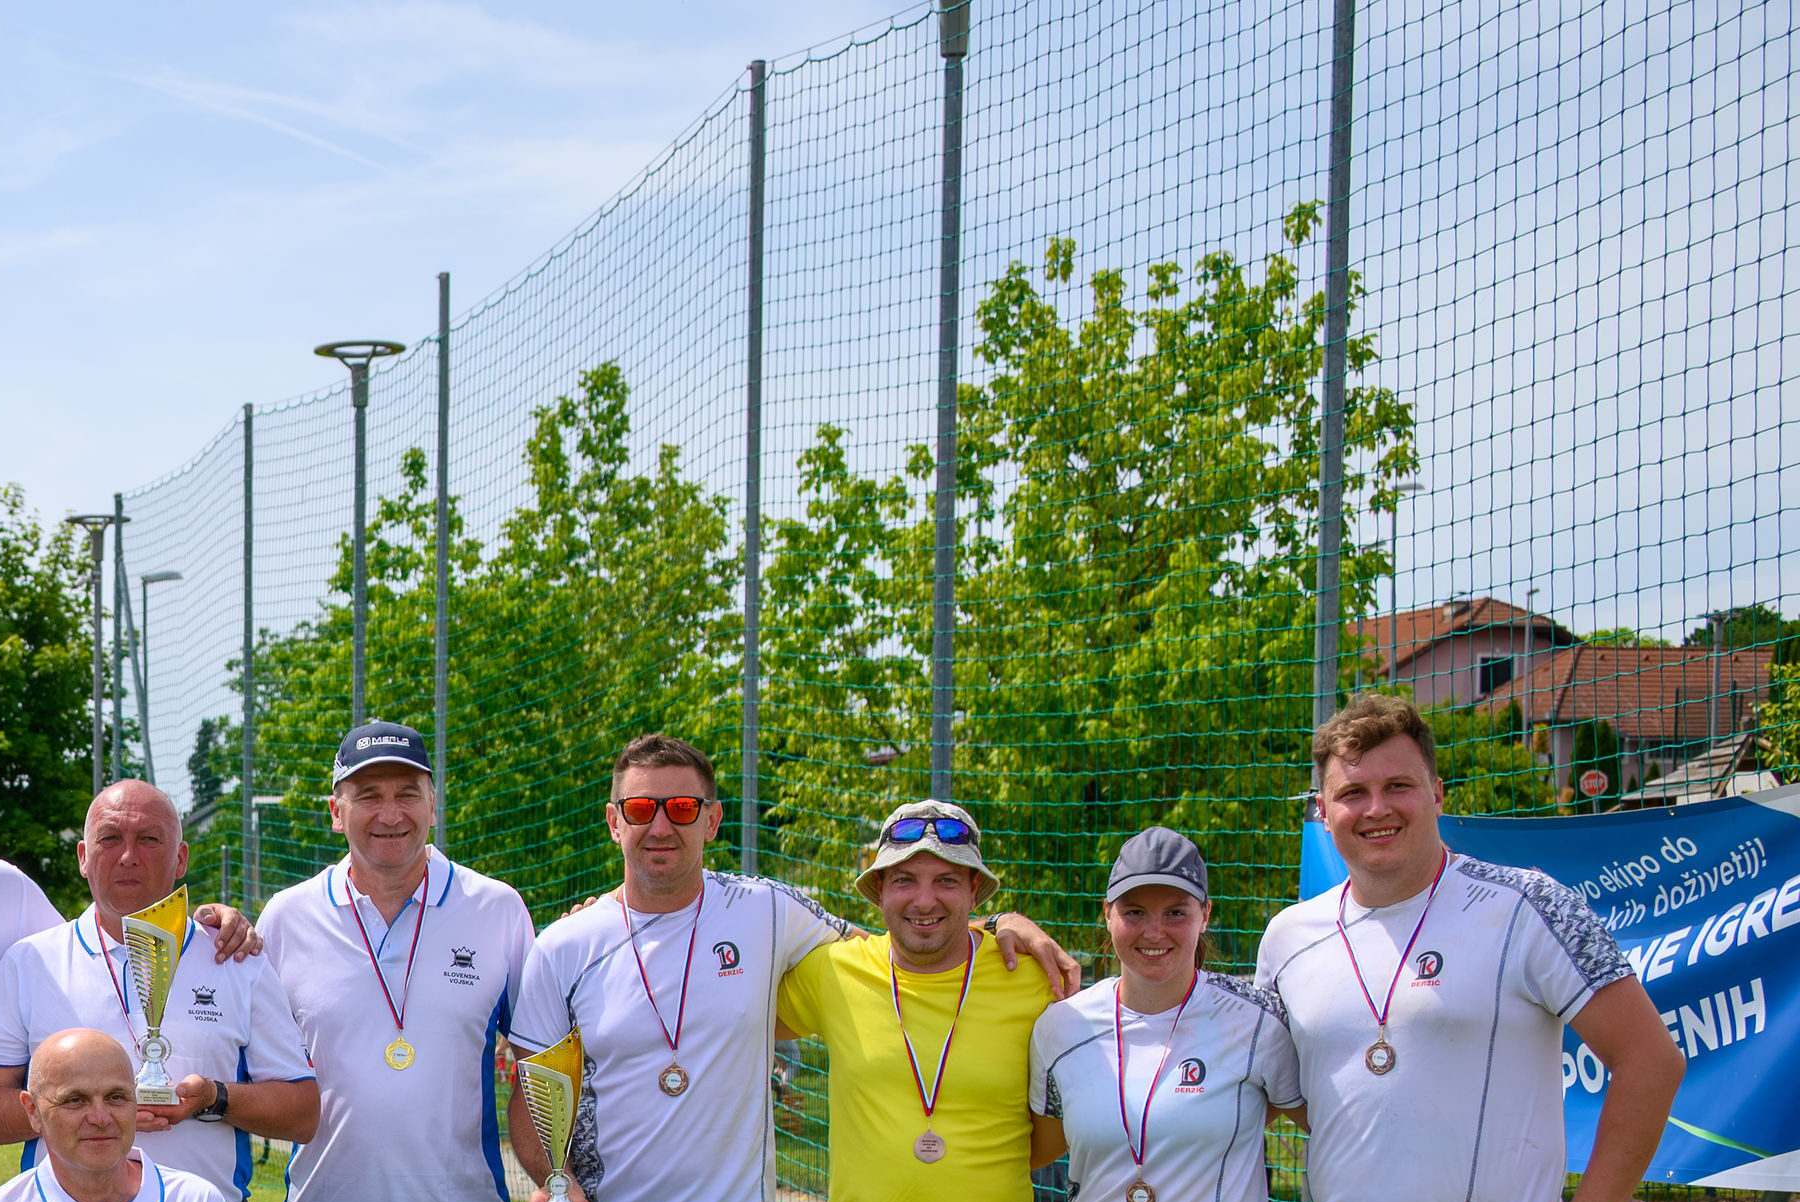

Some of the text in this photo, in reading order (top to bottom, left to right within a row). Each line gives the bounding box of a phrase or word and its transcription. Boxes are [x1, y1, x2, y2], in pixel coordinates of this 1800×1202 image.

[371, 735, 410, 747] MERLO
[1599, 855, 1661, 893] ekipo
[1660, 836, 1698, 864] do
[1600, 837, 1767, 931] kih doživetij!
[1621, 873, 1800, 984] NE IGRE
[443, 971, 481, 981] SLOVENSKA
[449, 978, 474, 986] VOJSKA
[188, 1009, 224, 1018] SLOVENSKA
[1562, 977, 1766, 1102] POENIH
